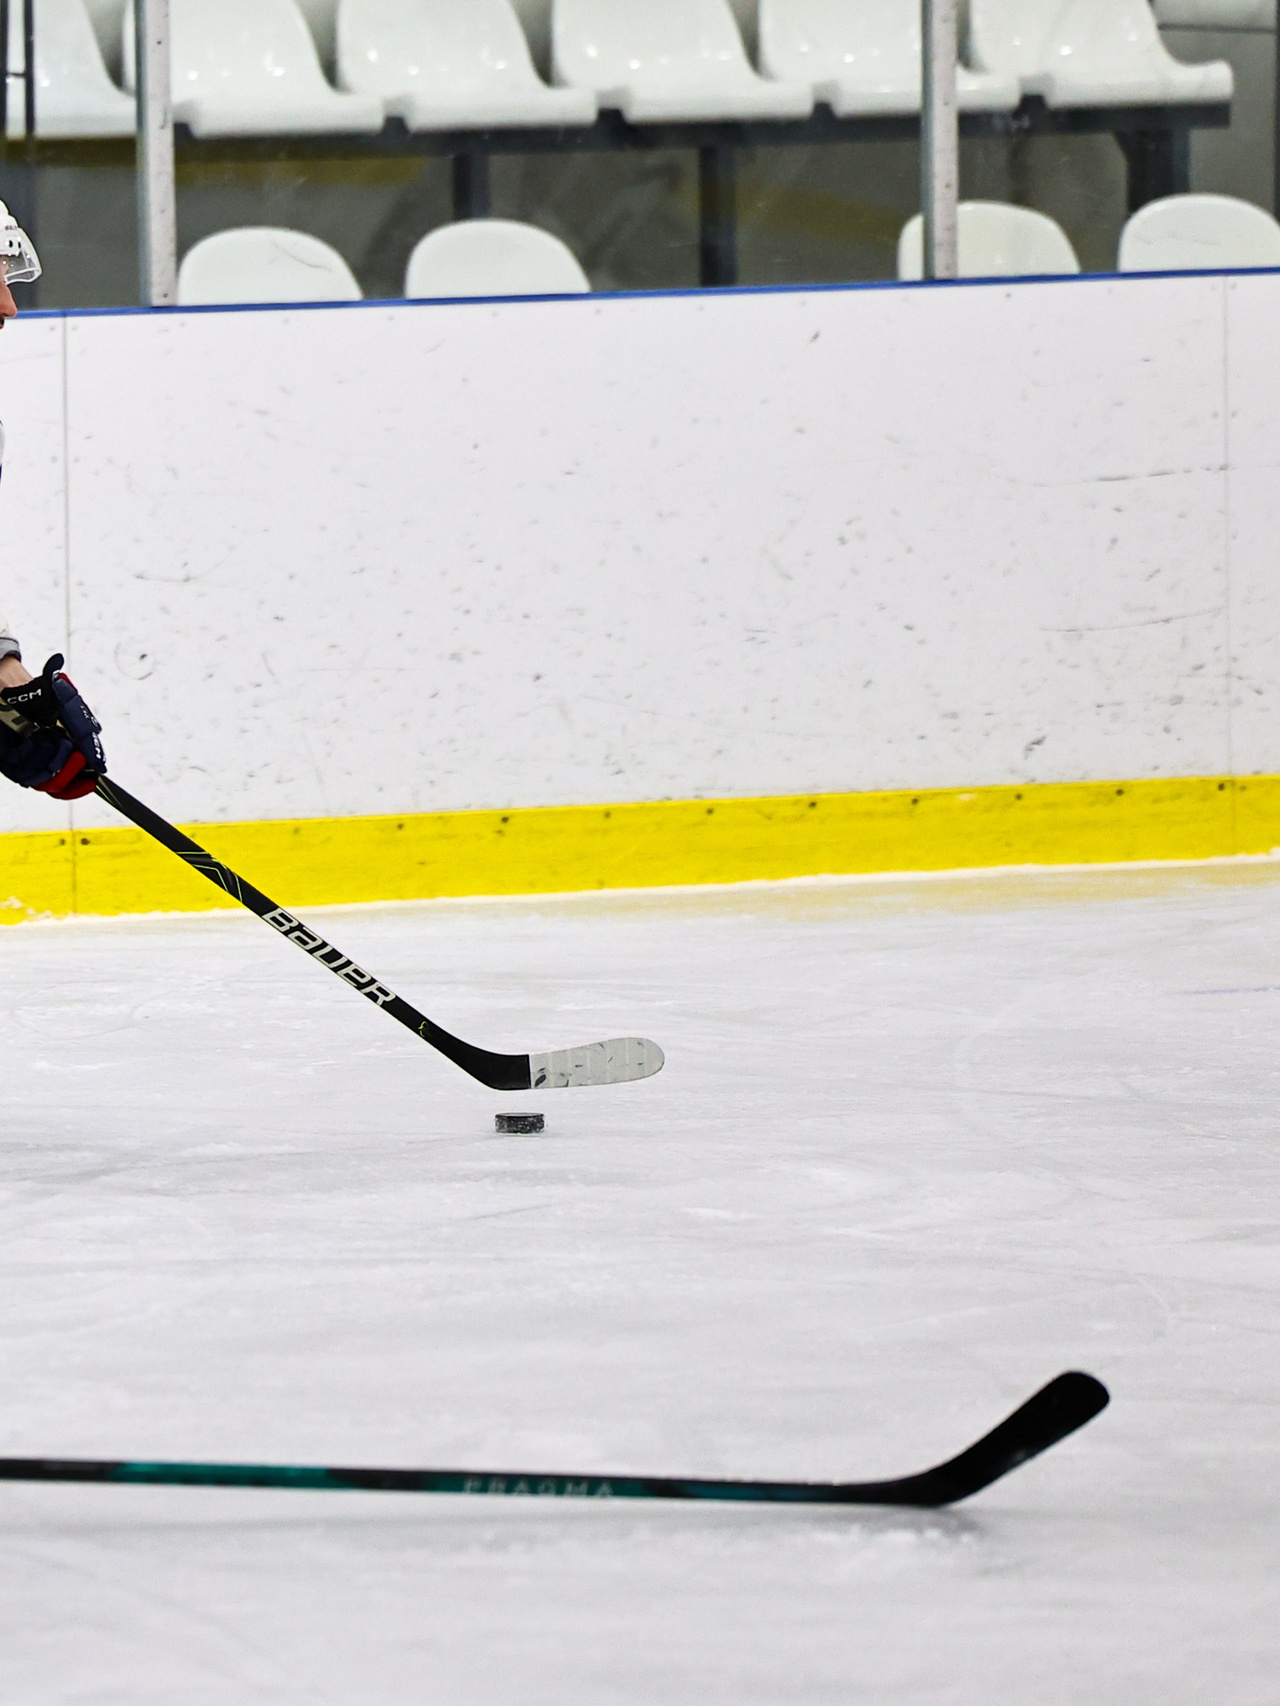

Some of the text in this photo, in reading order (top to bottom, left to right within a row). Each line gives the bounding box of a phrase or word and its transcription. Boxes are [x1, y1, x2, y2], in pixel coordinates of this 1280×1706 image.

[6, 688, 42, 704] CCM
[261, 907, 397, 1007] BAUER
[462, 1475, 615, 1498] PRAGMA
